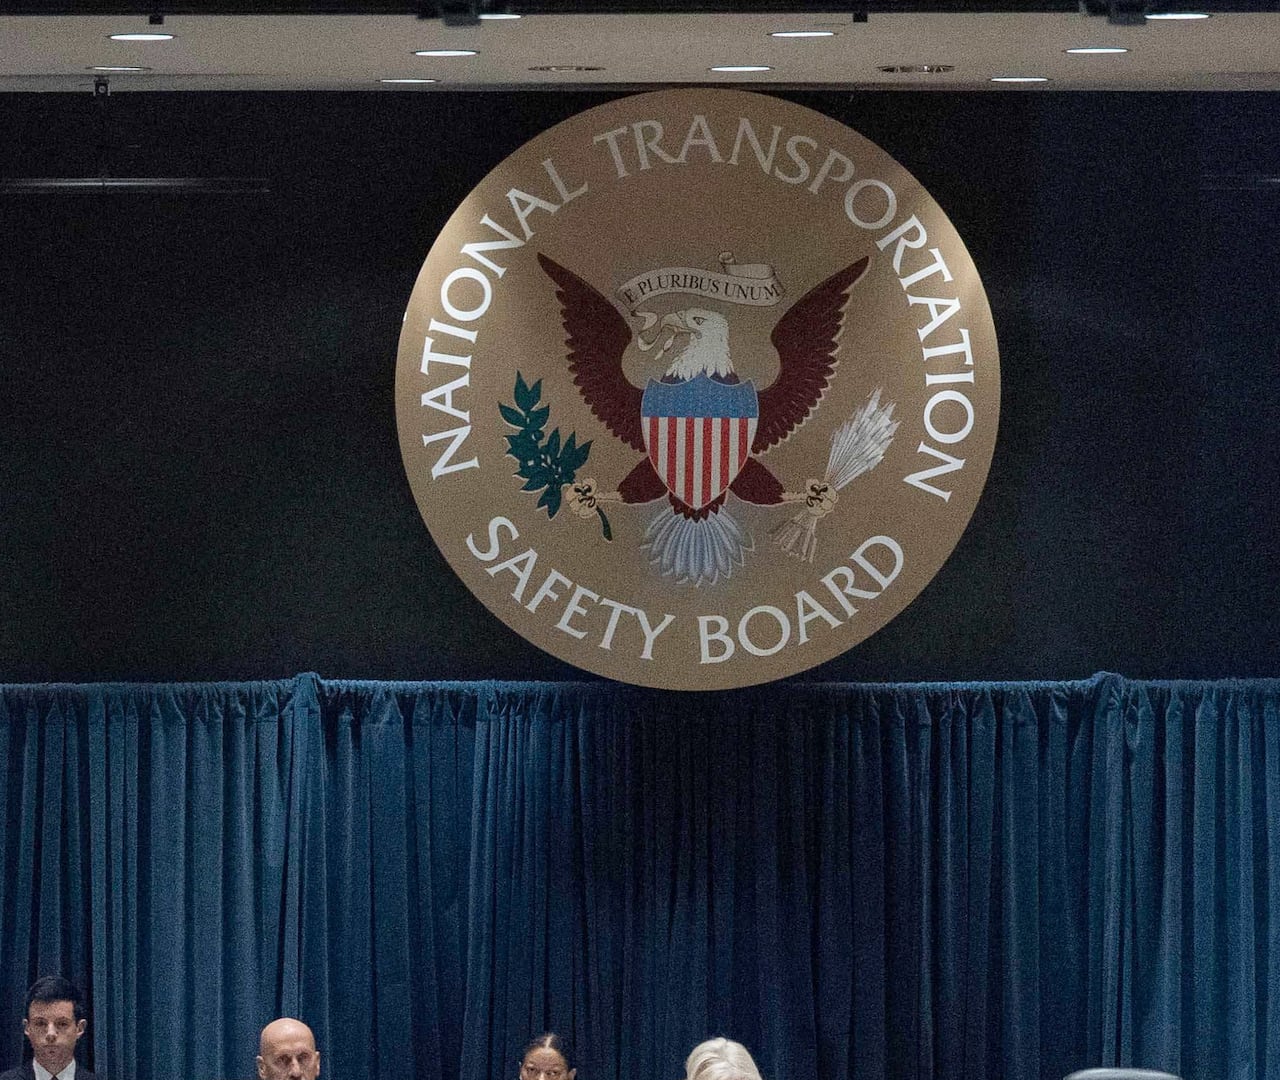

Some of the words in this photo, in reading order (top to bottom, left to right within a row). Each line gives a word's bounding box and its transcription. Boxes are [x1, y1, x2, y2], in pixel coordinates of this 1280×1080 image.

[421, 157, 589, 480] NATIONAL
[593, 114, 976, 501] TRANSPORTATION
[624, 288, 639, 304] E
[638, 273, 721, 296] PLURIBUS
[724, 281, 782, 301] UNUM
[466, 515, 676, 661] SAFETY
[697, 535, 906, 665] BOARD
